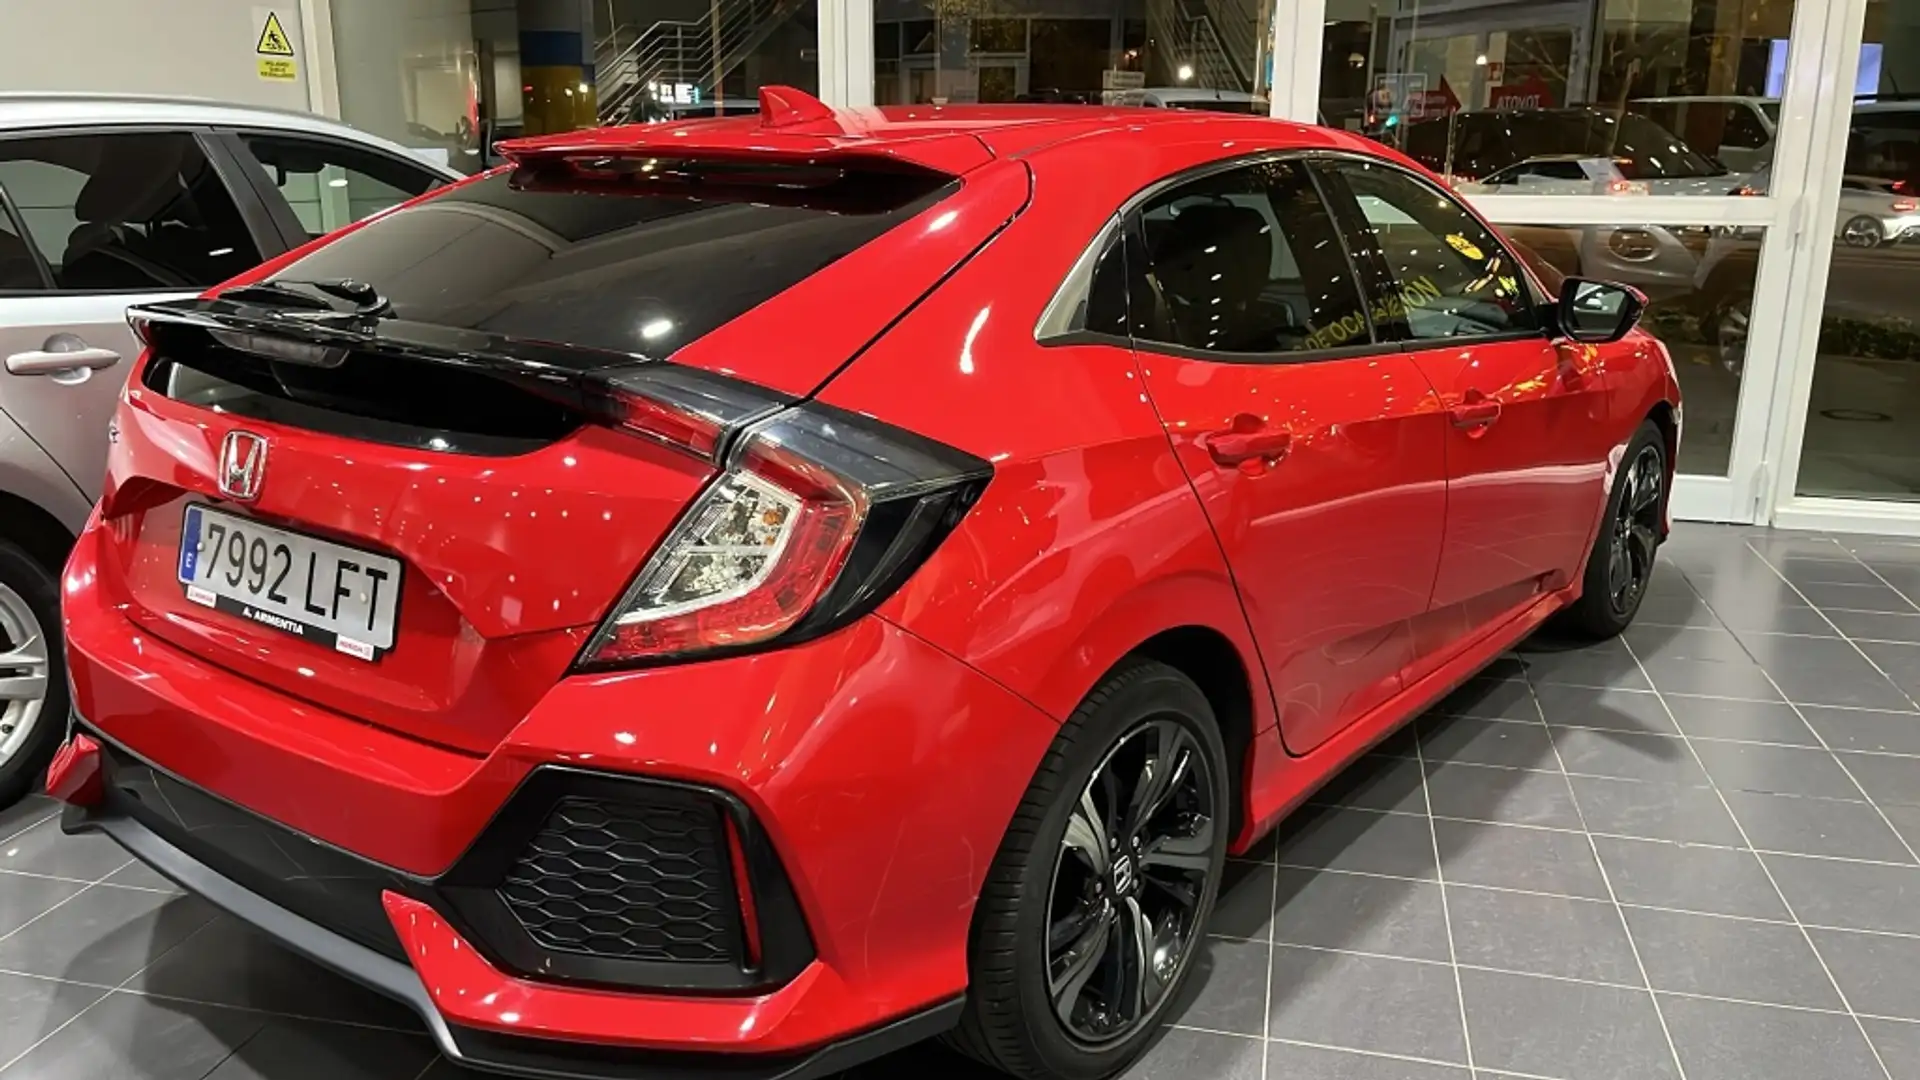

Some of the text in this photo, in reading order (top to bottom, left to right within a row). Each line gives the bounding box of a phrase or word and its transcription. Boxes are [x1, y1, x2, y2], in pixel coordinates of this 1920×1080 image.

[206, 523, 388, 632] 7992 LFT
[253, 610, 304, 635] ARMENTIA
